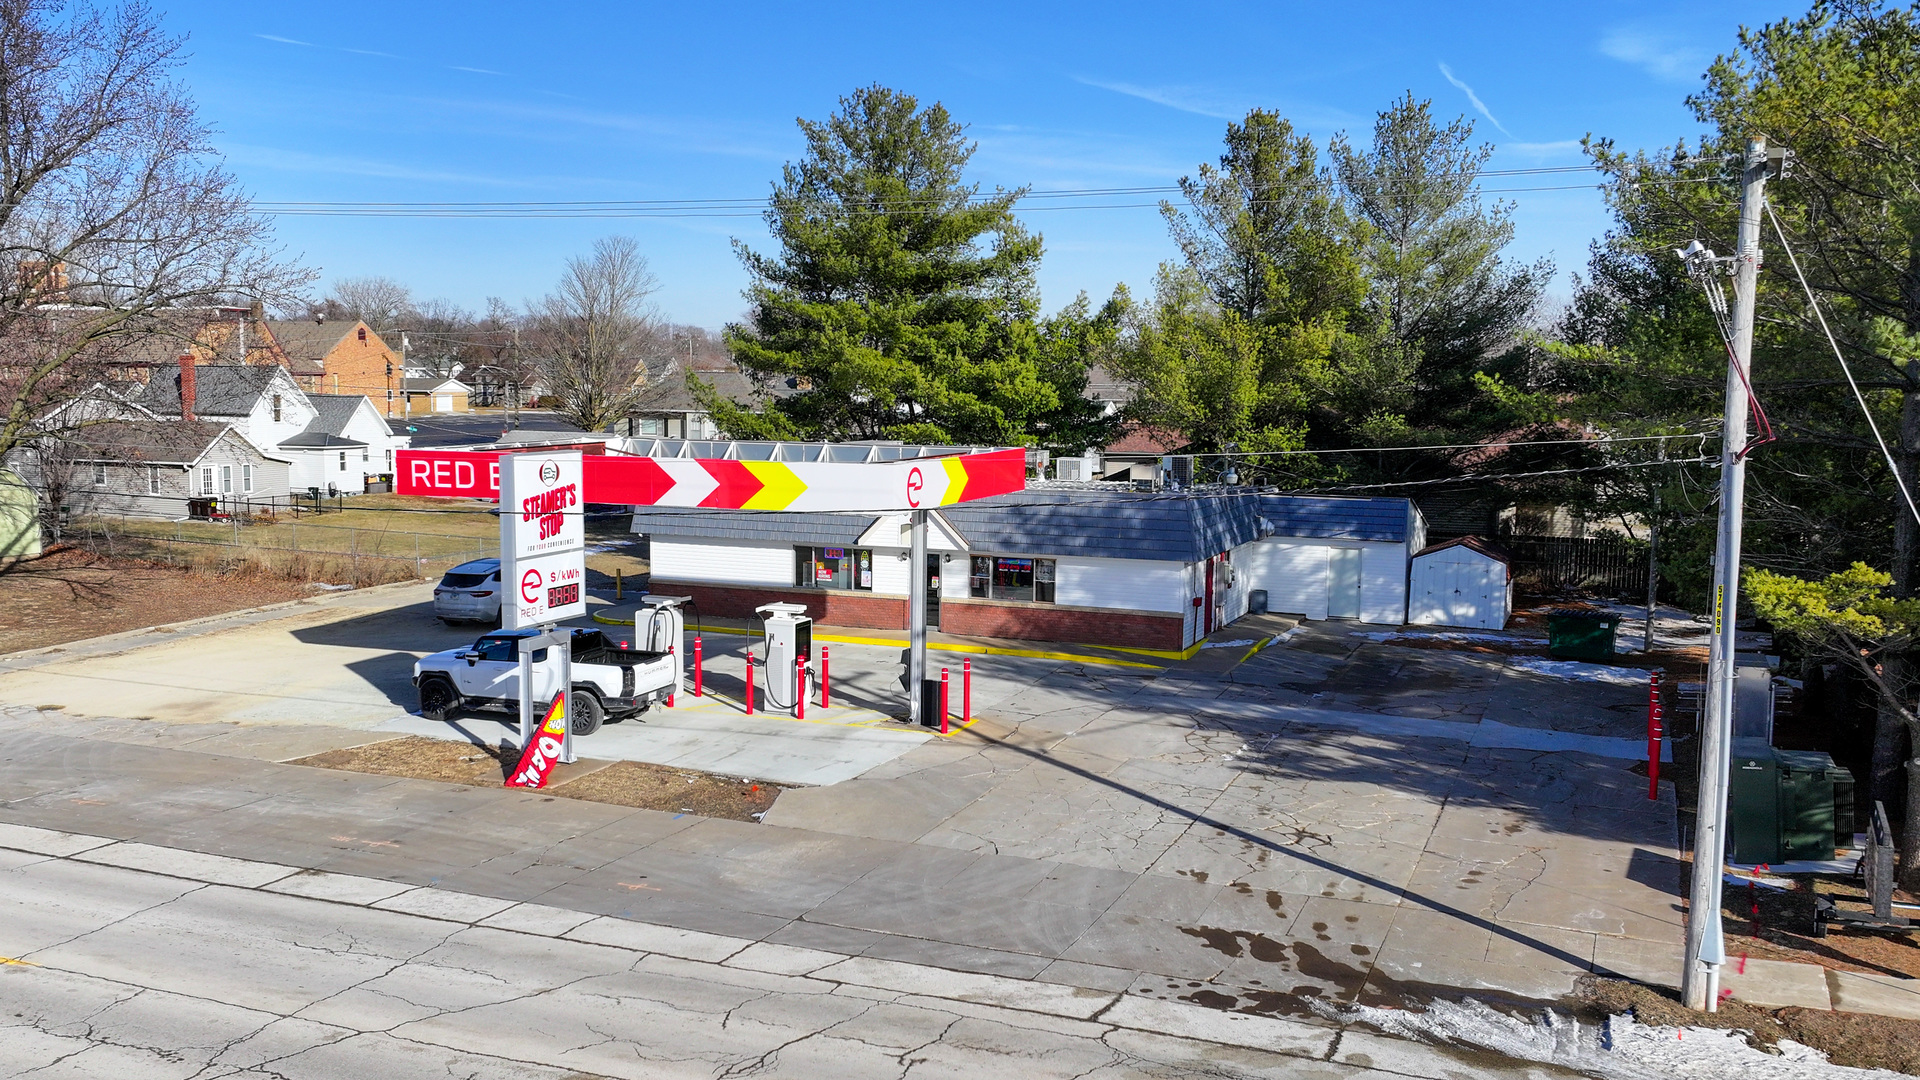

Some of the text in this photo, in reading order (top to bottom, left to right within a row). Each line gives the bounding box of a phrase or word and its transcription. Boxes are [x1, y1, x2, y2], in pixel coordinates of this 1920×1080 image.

[411, 460, 500, 490] RED E
[523, 483, 577, 522] STEAMER'S
[540, 511, 564, 541] STOP
[521, 605, 544, 618] RED E
